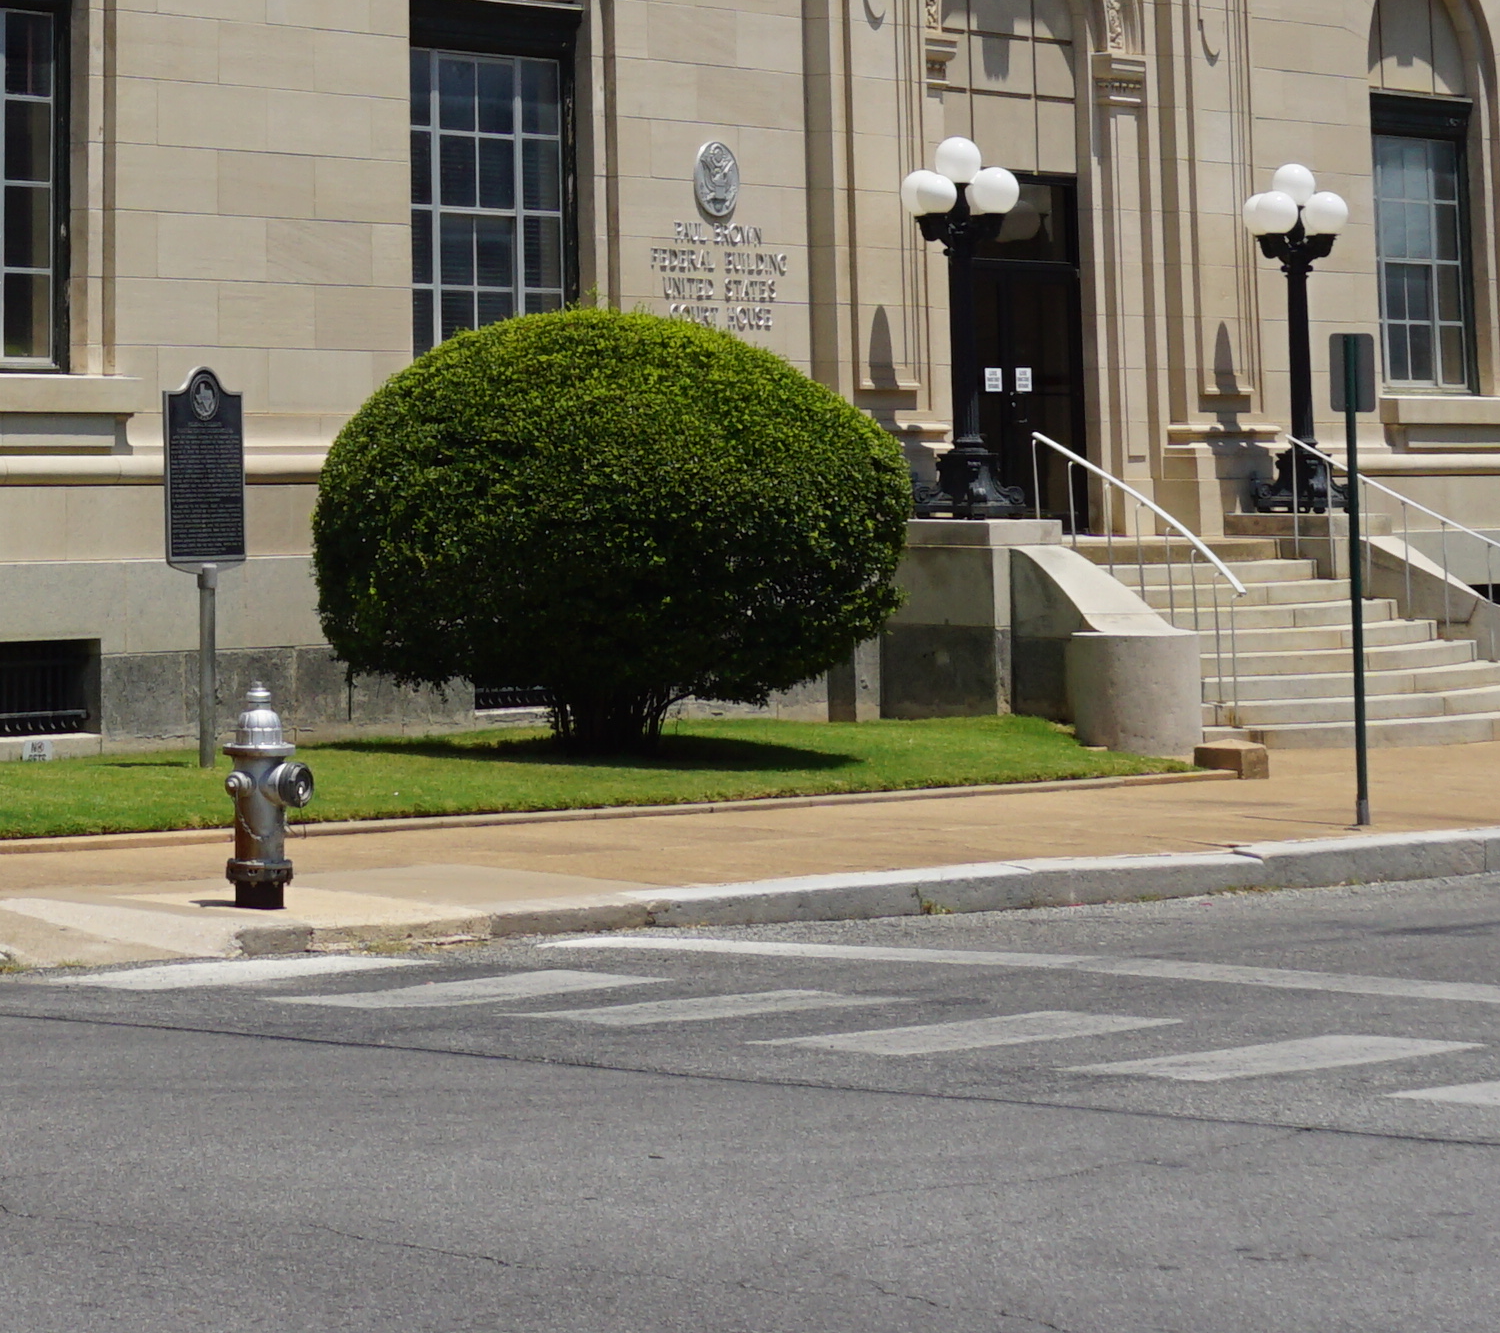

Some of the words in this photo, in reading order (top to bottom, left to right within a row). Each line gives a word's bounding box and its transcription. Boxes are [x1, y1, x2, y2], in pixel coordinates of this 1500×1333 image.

[674, 222, 707, 244] PAUL
[713, 222, 762, 247] BROWN
[650, 247, 715, 272] FEDERAL
[725, 251, 788, 276] BUILDING
[662, 276, 714, 300] UNITED
[725, 278, 777, 303] STATES
[670, 303, 719, 326] COURT
[727, 306, 773, 331] HOUSE
